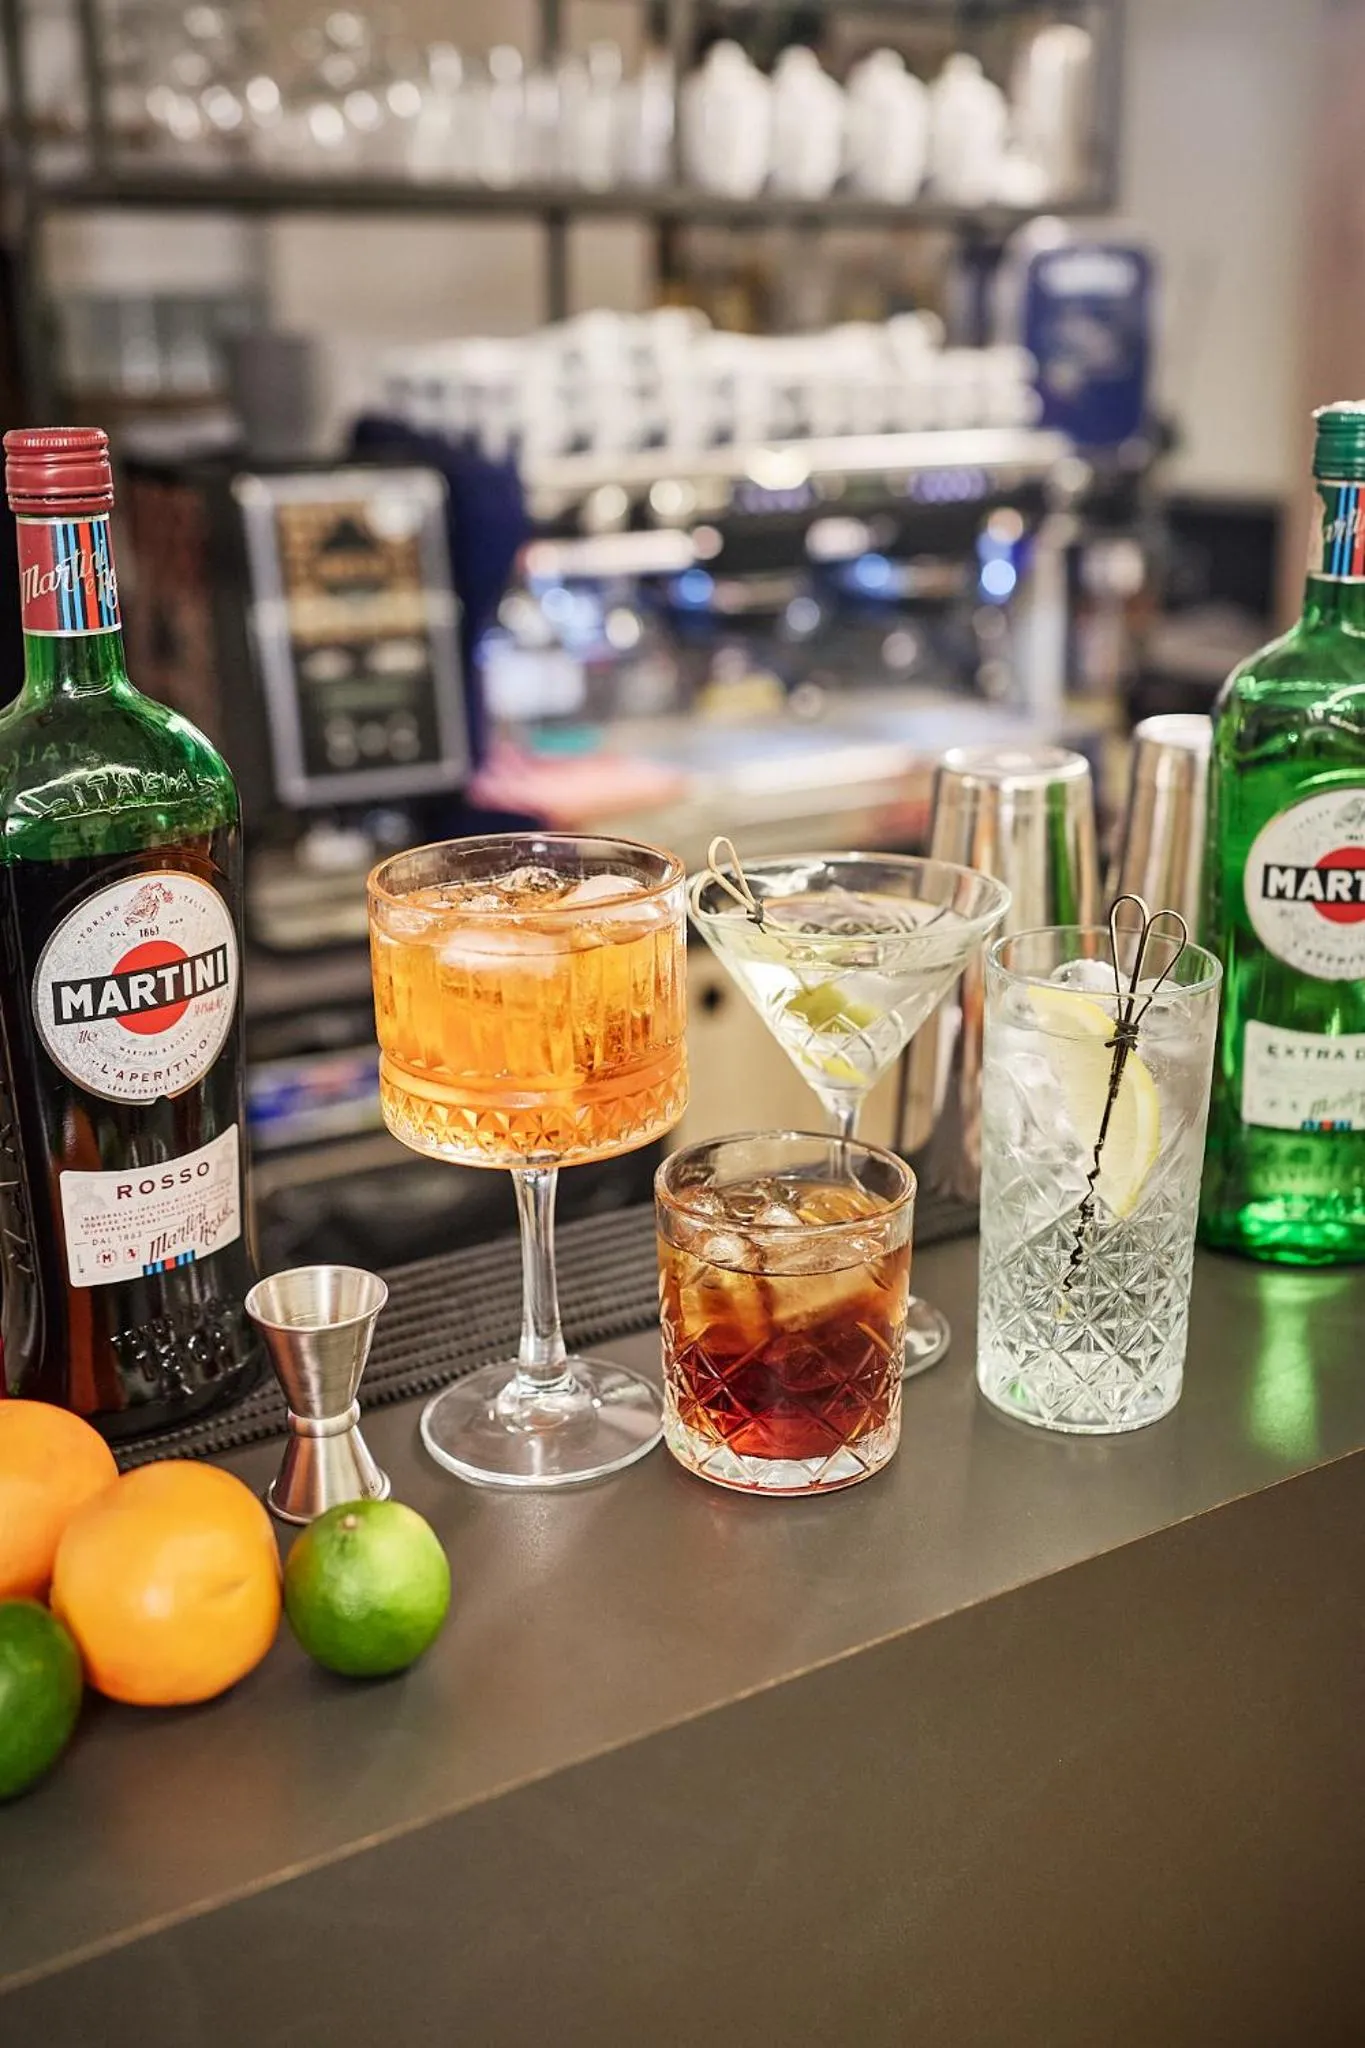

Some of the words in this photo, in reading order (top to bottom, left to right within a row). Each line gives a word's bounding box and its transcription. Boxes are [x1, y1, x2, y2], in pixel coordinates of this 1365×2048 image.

[22, 539, 108, 614] Martini
[60, 949, 225, 1020] MARTINI
[1267, 1044, 1345, 1060] EXTRA
[117, 1161, 211, 1200] ROSSO
